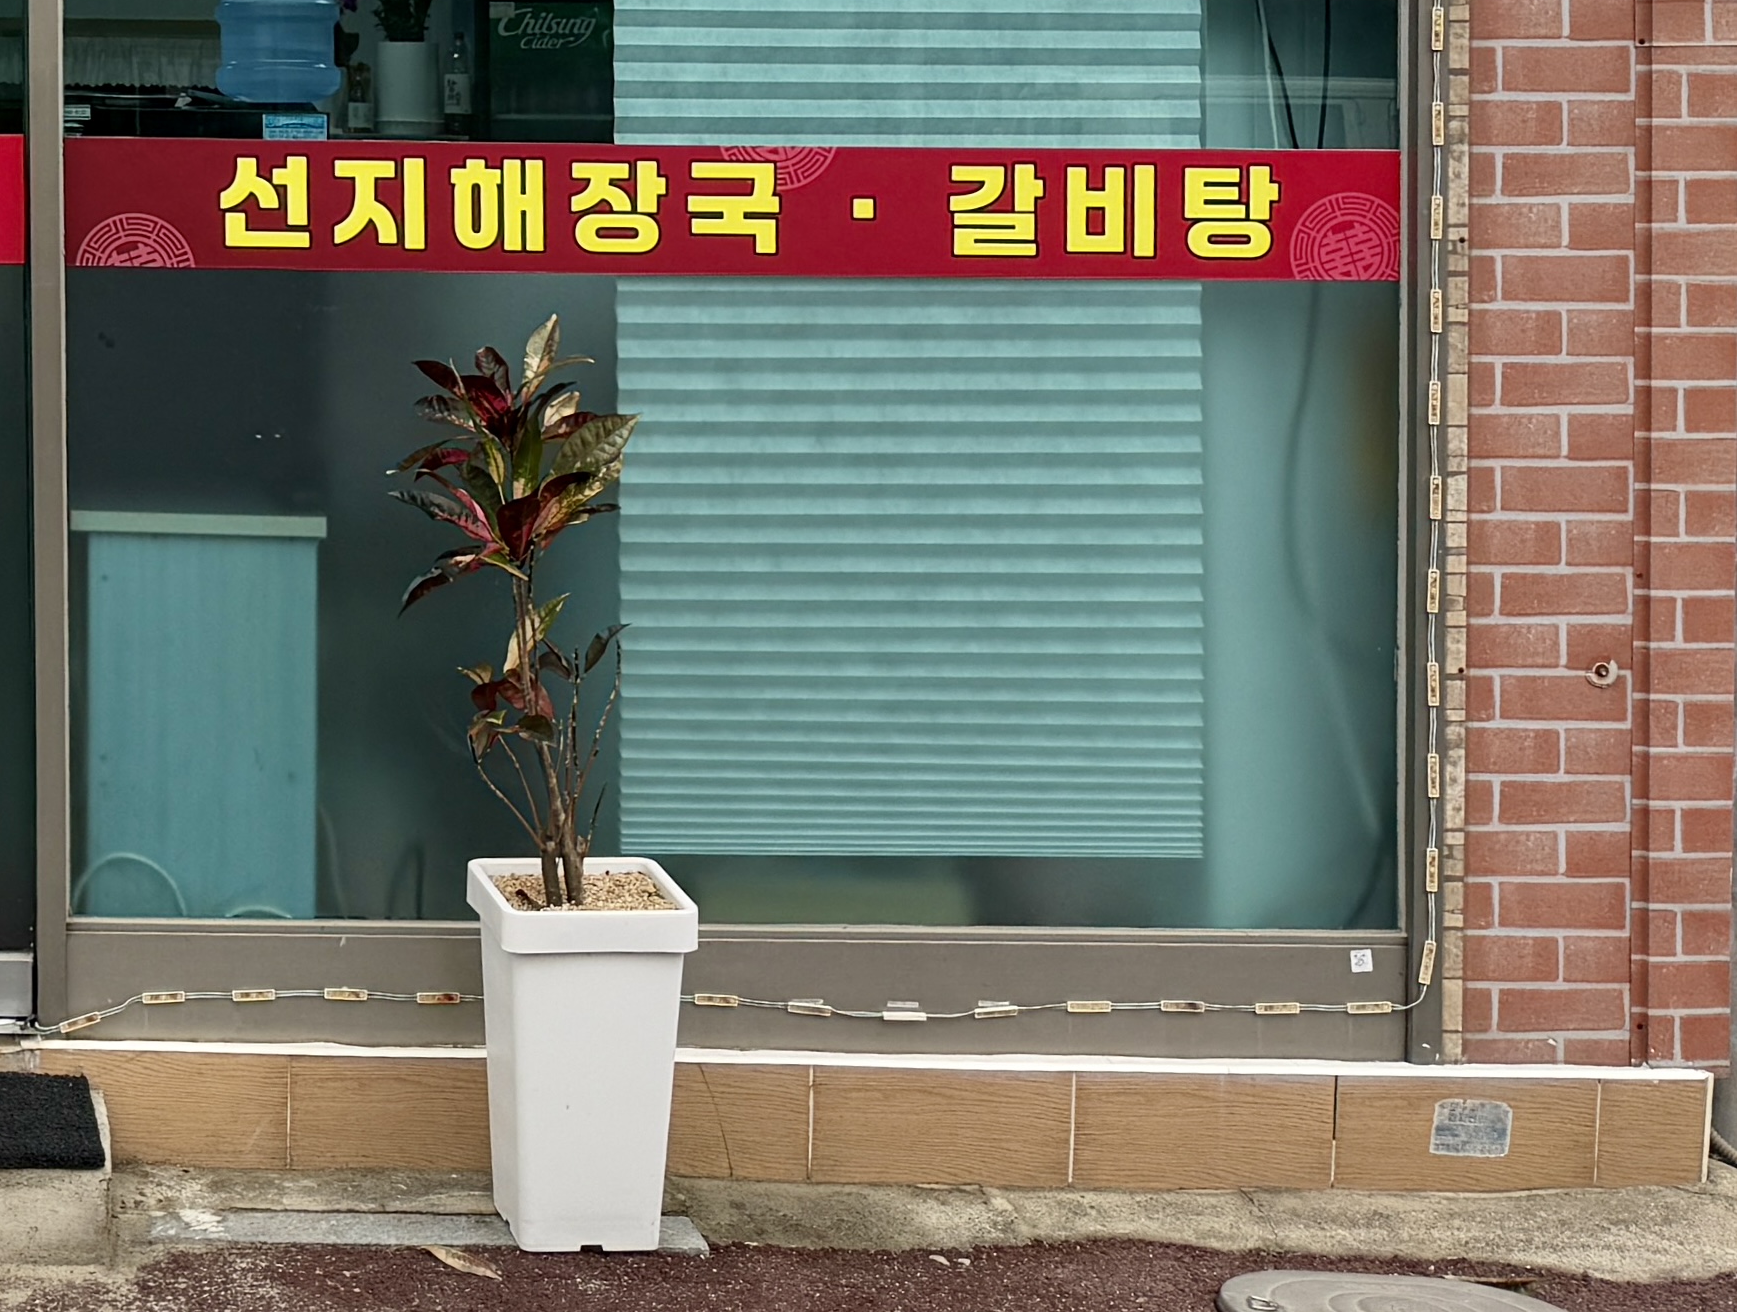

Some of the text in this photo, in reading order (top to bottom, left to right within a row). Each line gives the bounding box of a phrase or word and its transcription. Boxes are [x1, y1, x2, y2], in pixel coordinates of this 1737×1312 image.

[498, 8, 598, 40] Chilsung
[221, 156, 781, 255] 선지해장국
[950, 163, 1280, 259] 갈비탕
